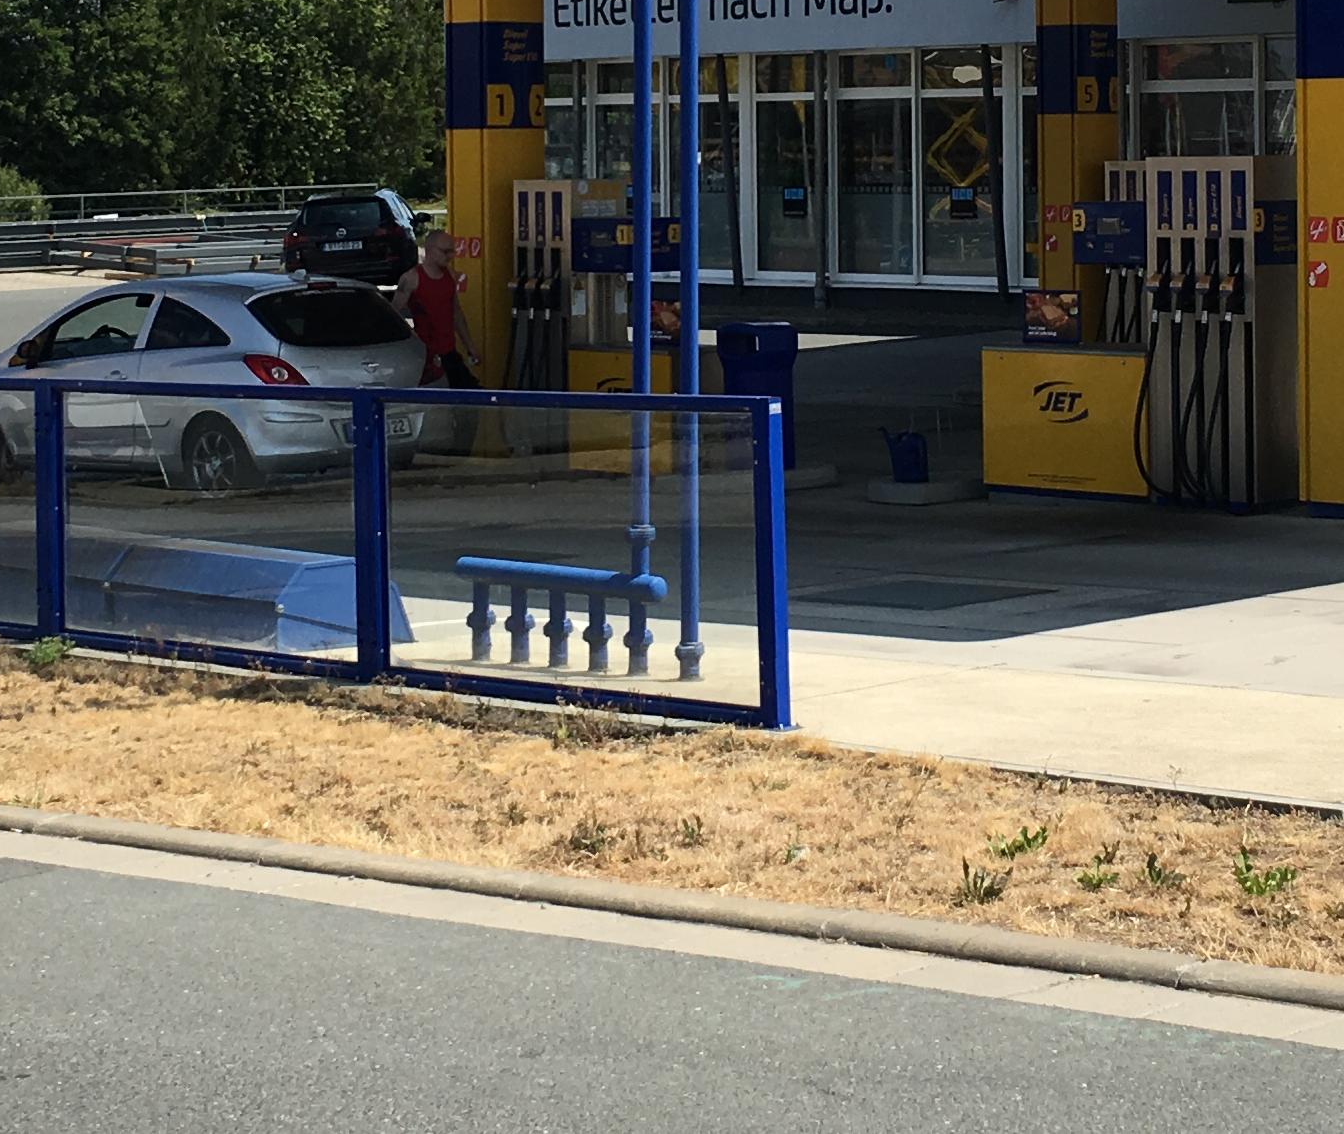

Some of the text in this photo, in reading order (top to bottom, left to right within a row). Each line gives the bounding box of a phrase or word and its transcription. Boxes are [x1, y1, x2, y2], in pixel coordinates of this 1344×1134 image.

[1084, 84, 1093, 104] 5
[496, 94, 505, 117] 1
[1040, 392, 1083, 412] JET
